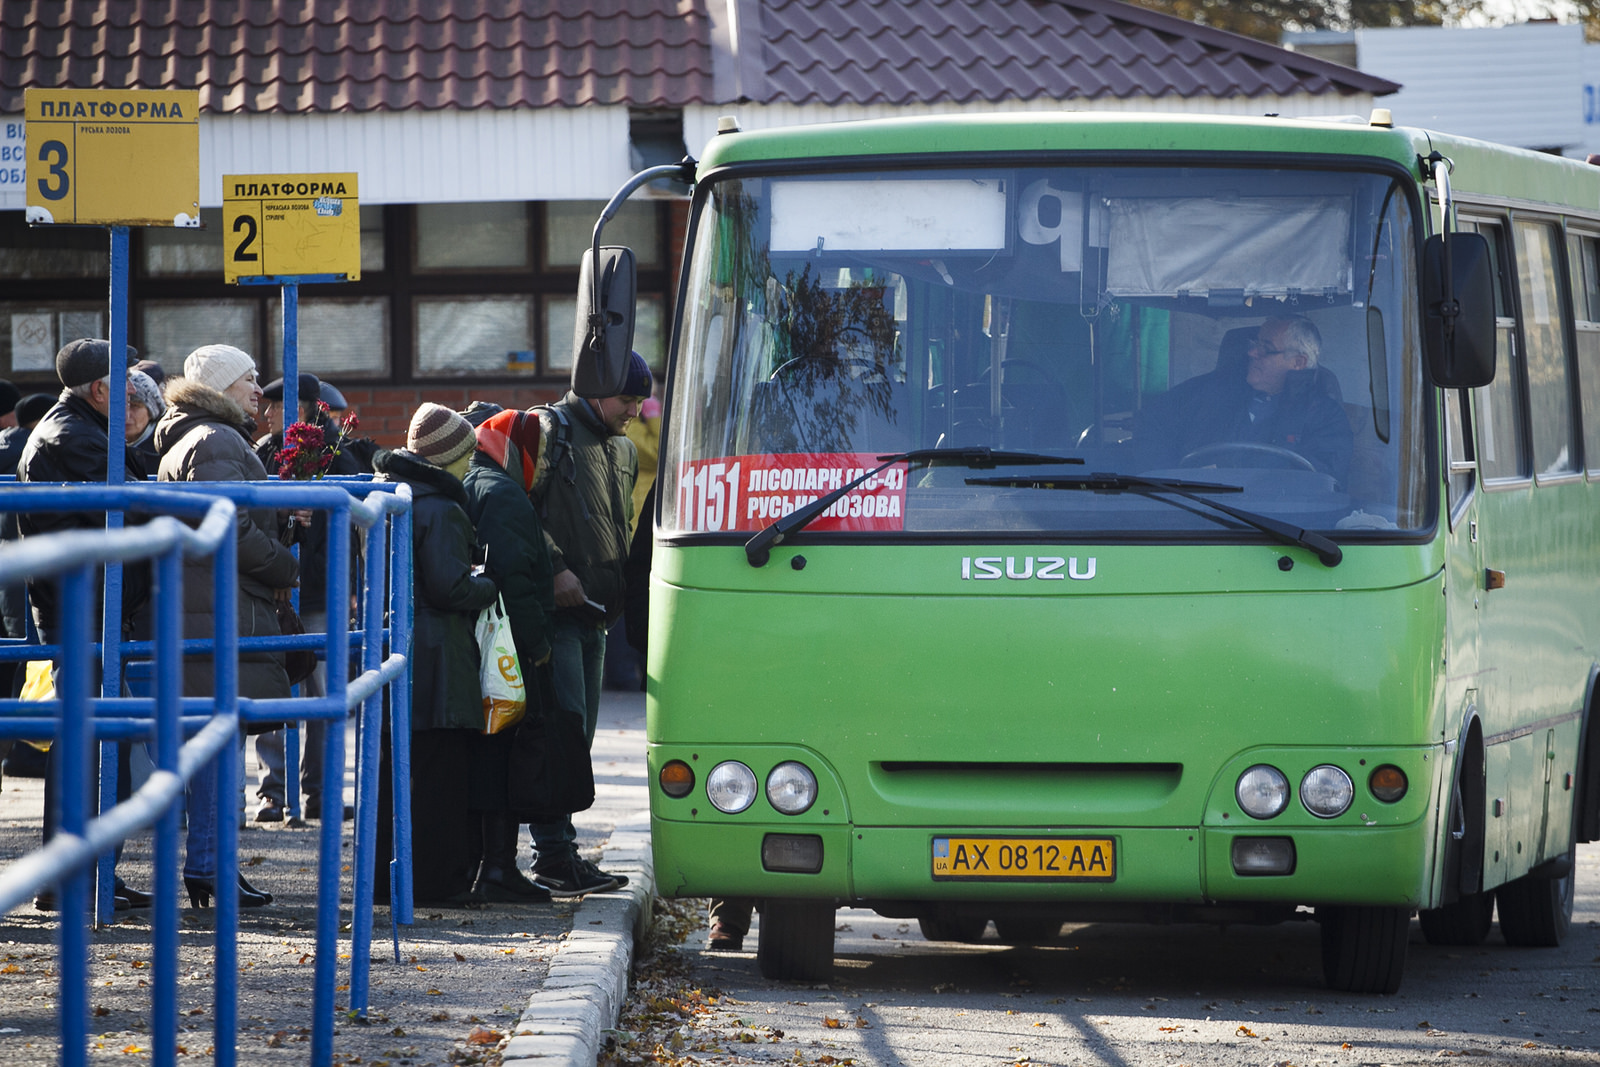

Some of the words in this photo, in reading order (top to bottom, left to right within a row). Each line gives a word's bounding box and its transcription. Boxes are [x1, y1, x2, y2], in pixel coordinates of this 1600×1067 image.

[40, 101, 184, 119] ПЛАТФОРМА
[6, 123, 26, 141] ВІ
[80, 126, 104, 134] РУСЬКА
[105, 126, 131, 135] ЛОЗОВА
[2, 146, 26, 161] ВС
[37, 139, 70, 201] 3
[234, 182, 347, 197] ПЛАТФОРМА
[232, 214, 259, 262] 2
[747, 468, 842, 492] ЛІСОПАРК
[681, 461, 741, 531] 1151
[961, 556, 1097, 580] ISUZU
[936, 862, 948, 870] UA
[952, 844, 990, 870] AX
[999, 844, 1060, 871] 0812
[1068, 845, 1107, 872] AA
